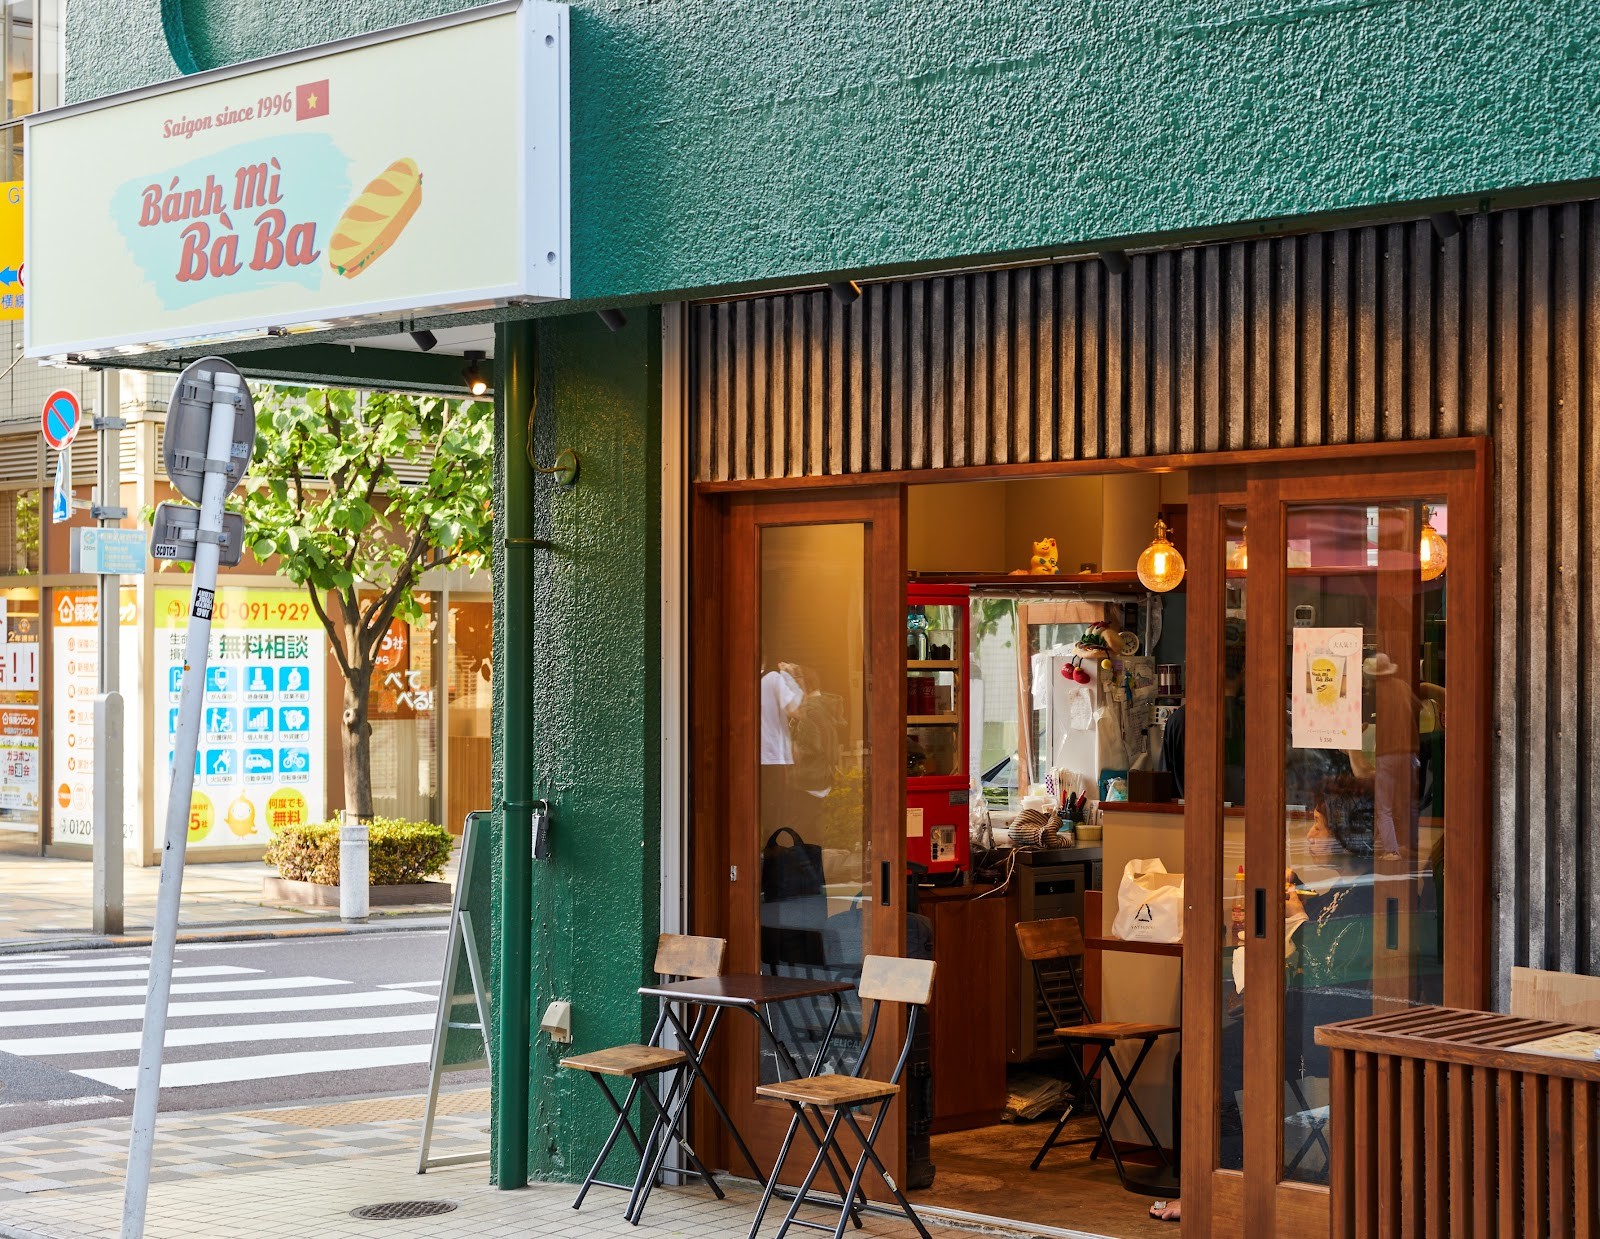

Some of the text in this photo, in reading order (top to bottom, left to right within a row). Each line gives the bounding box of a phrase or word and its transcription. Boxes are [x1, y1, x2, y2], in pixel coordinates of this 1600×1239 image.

[163, 91, 293, 139] Saigon since 1996
[8, 187, 24, 204] G
[138, 156, 284, 227] Bánh Mì
[175, 208, 321, 282] Bà Ba
[156, 545, 177, 557] SCOTCH
[219, 634, 309, 659] 無料相談
[7, 751, 31, 762] ガラポン
[269, 799, 304, 809] 何度でも
[273, 811, 301, 827] 無料
